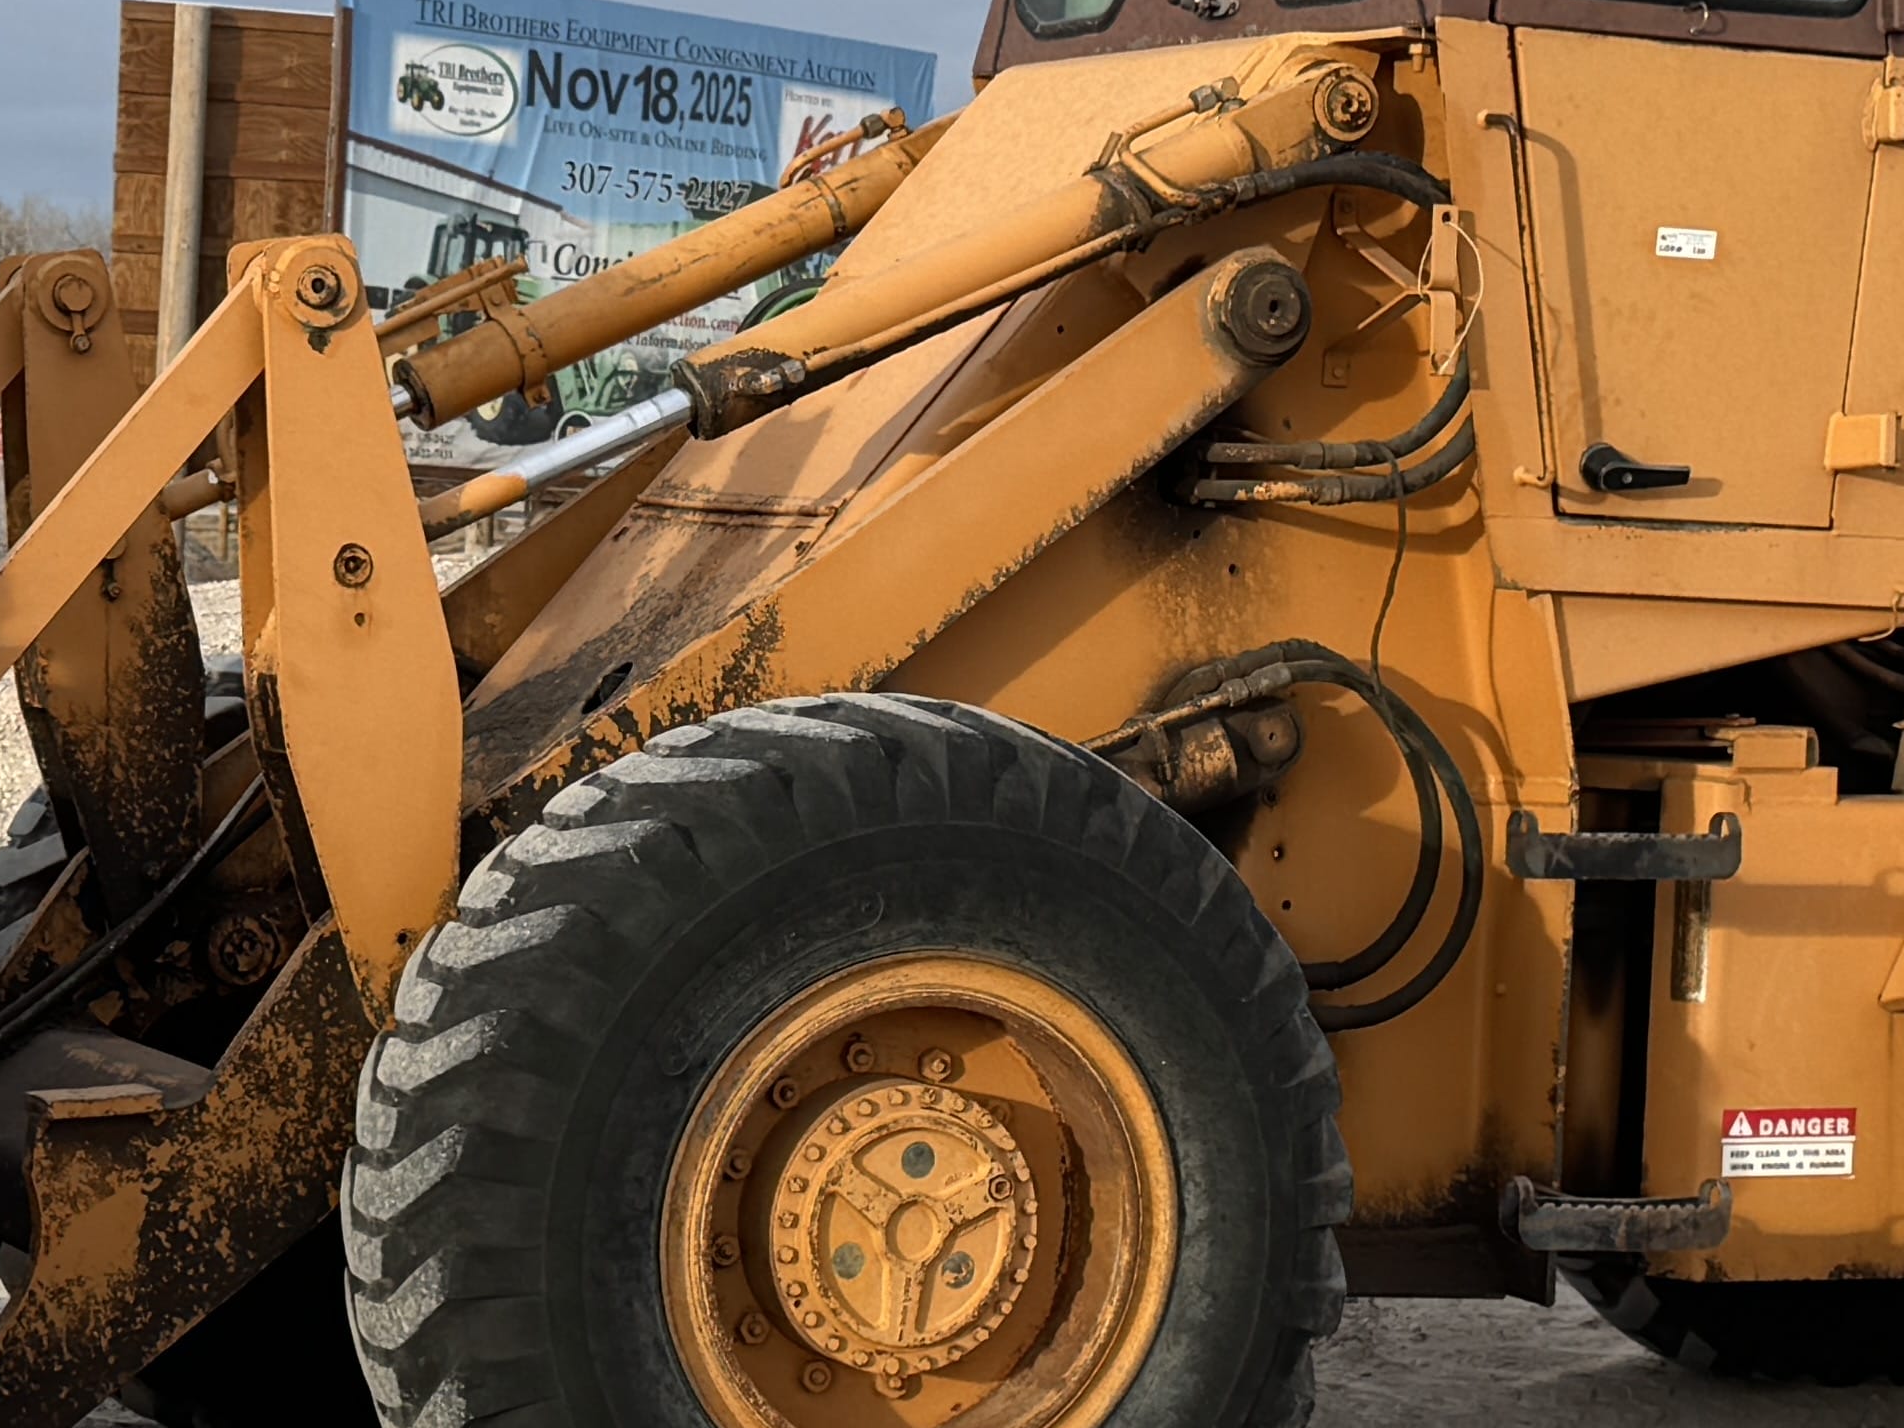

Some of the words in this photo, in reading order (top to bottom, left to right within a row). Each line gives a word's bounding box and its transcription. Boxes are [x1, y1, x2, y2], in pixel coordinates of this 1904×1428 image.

[462, 3, 560, 39] BROTHERS
[566, 18, 669, 56] EQUIPMENT
[674, 35, 798, 76] CONSIGNMENT
[801, 59, 876, 88] AUCTION
[526, 48, 630, 115] Nov
[689, 70, 753, 127] 2025
[543, 114, 576, 136] LIVE
[579, 119, 637, 143] ON-SITE
[639, 133, 650, 147] &
[654, 130, 707, 154] ONLINE
[711, 137, 768, 163] BIDDING
[561, 160, 753, 212] 307-575-2427
[1758, 1117, 1850, 1136] DANGER
